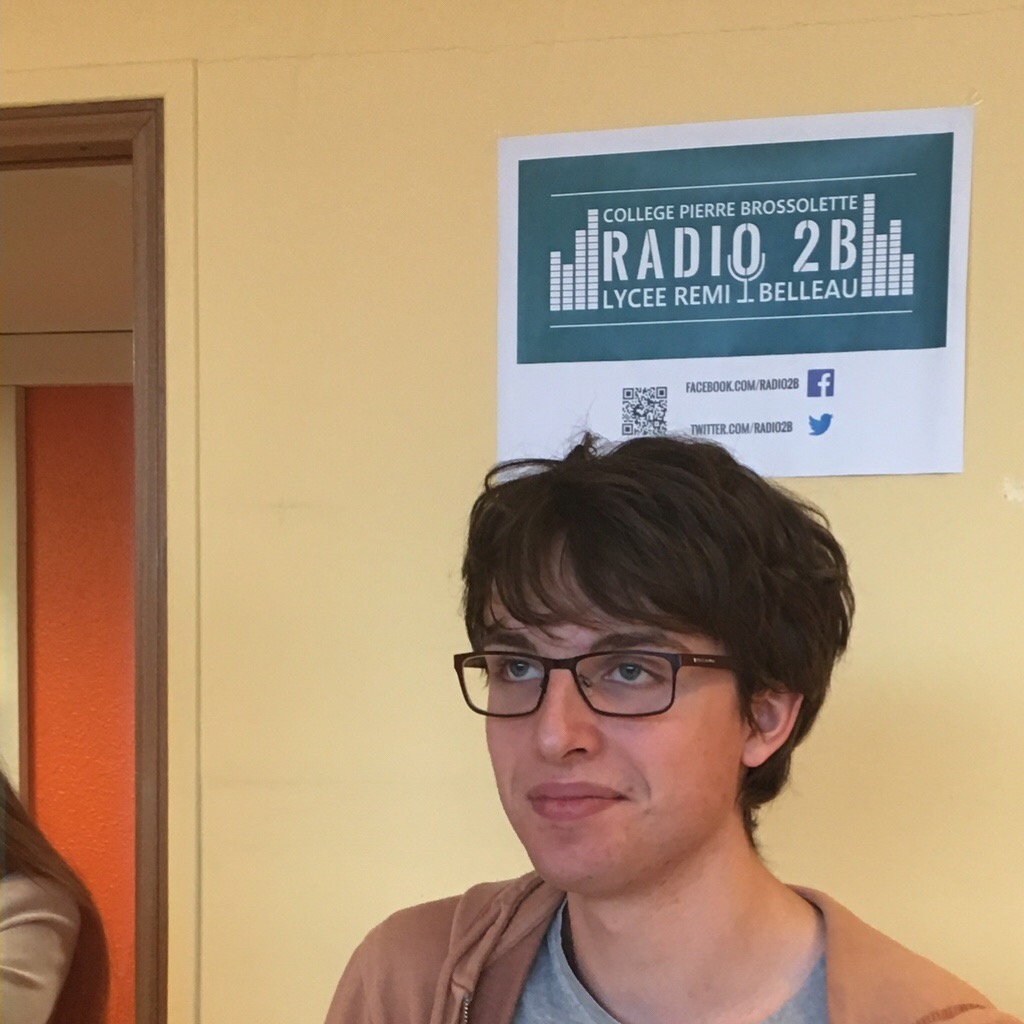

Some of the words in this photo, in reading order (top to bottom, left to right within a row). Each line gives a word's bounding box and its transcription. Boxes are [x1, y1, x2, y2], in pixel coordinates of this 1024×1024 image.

[603, 206, 674, 223] COLLEGE
[679, 202, 736, 219] PIERRE
[740, 195, 858, 216] BROSSOLETTE
[603, 223, 763, 282] RADIO
[793, 219, 858, 273] 2B
[603, 287, 667, 309] LYCEE
[674, 284, 730, 306] REMI
[760, 278, 858, 303] BELLEAU
[686, 377, 800, 393] FACEBOOK.COM/RADIO2B
[691, 421, 793, 436] TWITTER.COM/RADIO2B
